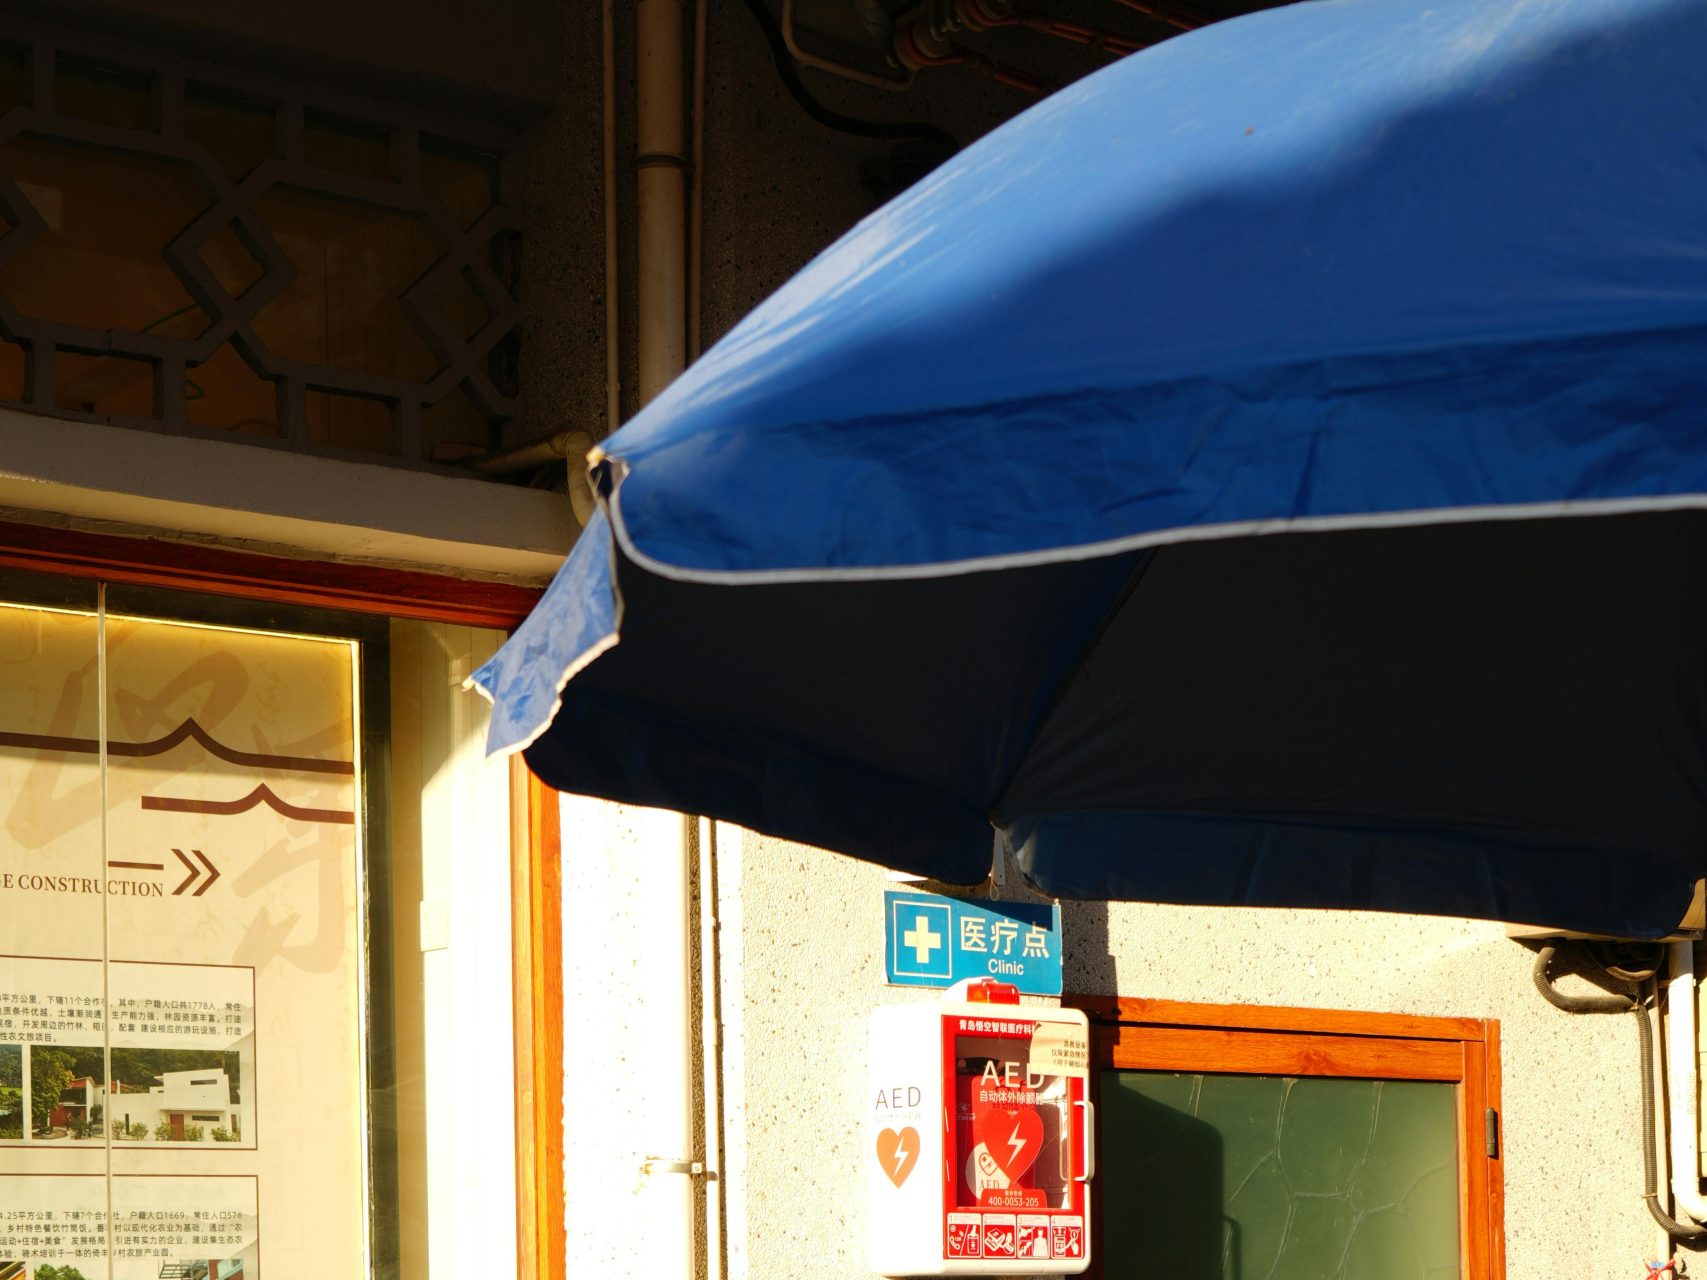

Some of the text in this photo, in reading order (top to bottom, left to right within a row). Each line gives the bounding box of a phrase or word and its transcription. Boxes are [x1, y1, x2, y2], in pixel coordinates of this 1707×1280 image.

[0, 873, 164, 897] E CONSTRUCTION
[960, 916, 1050, 959] 医疗点
[988, 958, 1024, 976] Clinic
[980, 1060, 1045, 1089] AED
[875, 1086, 921, 1110] AED
[980, 1090, 1045, 1105] 自动体外除颤器
[988, 1197, 1039, 1207] 400-0053-205
